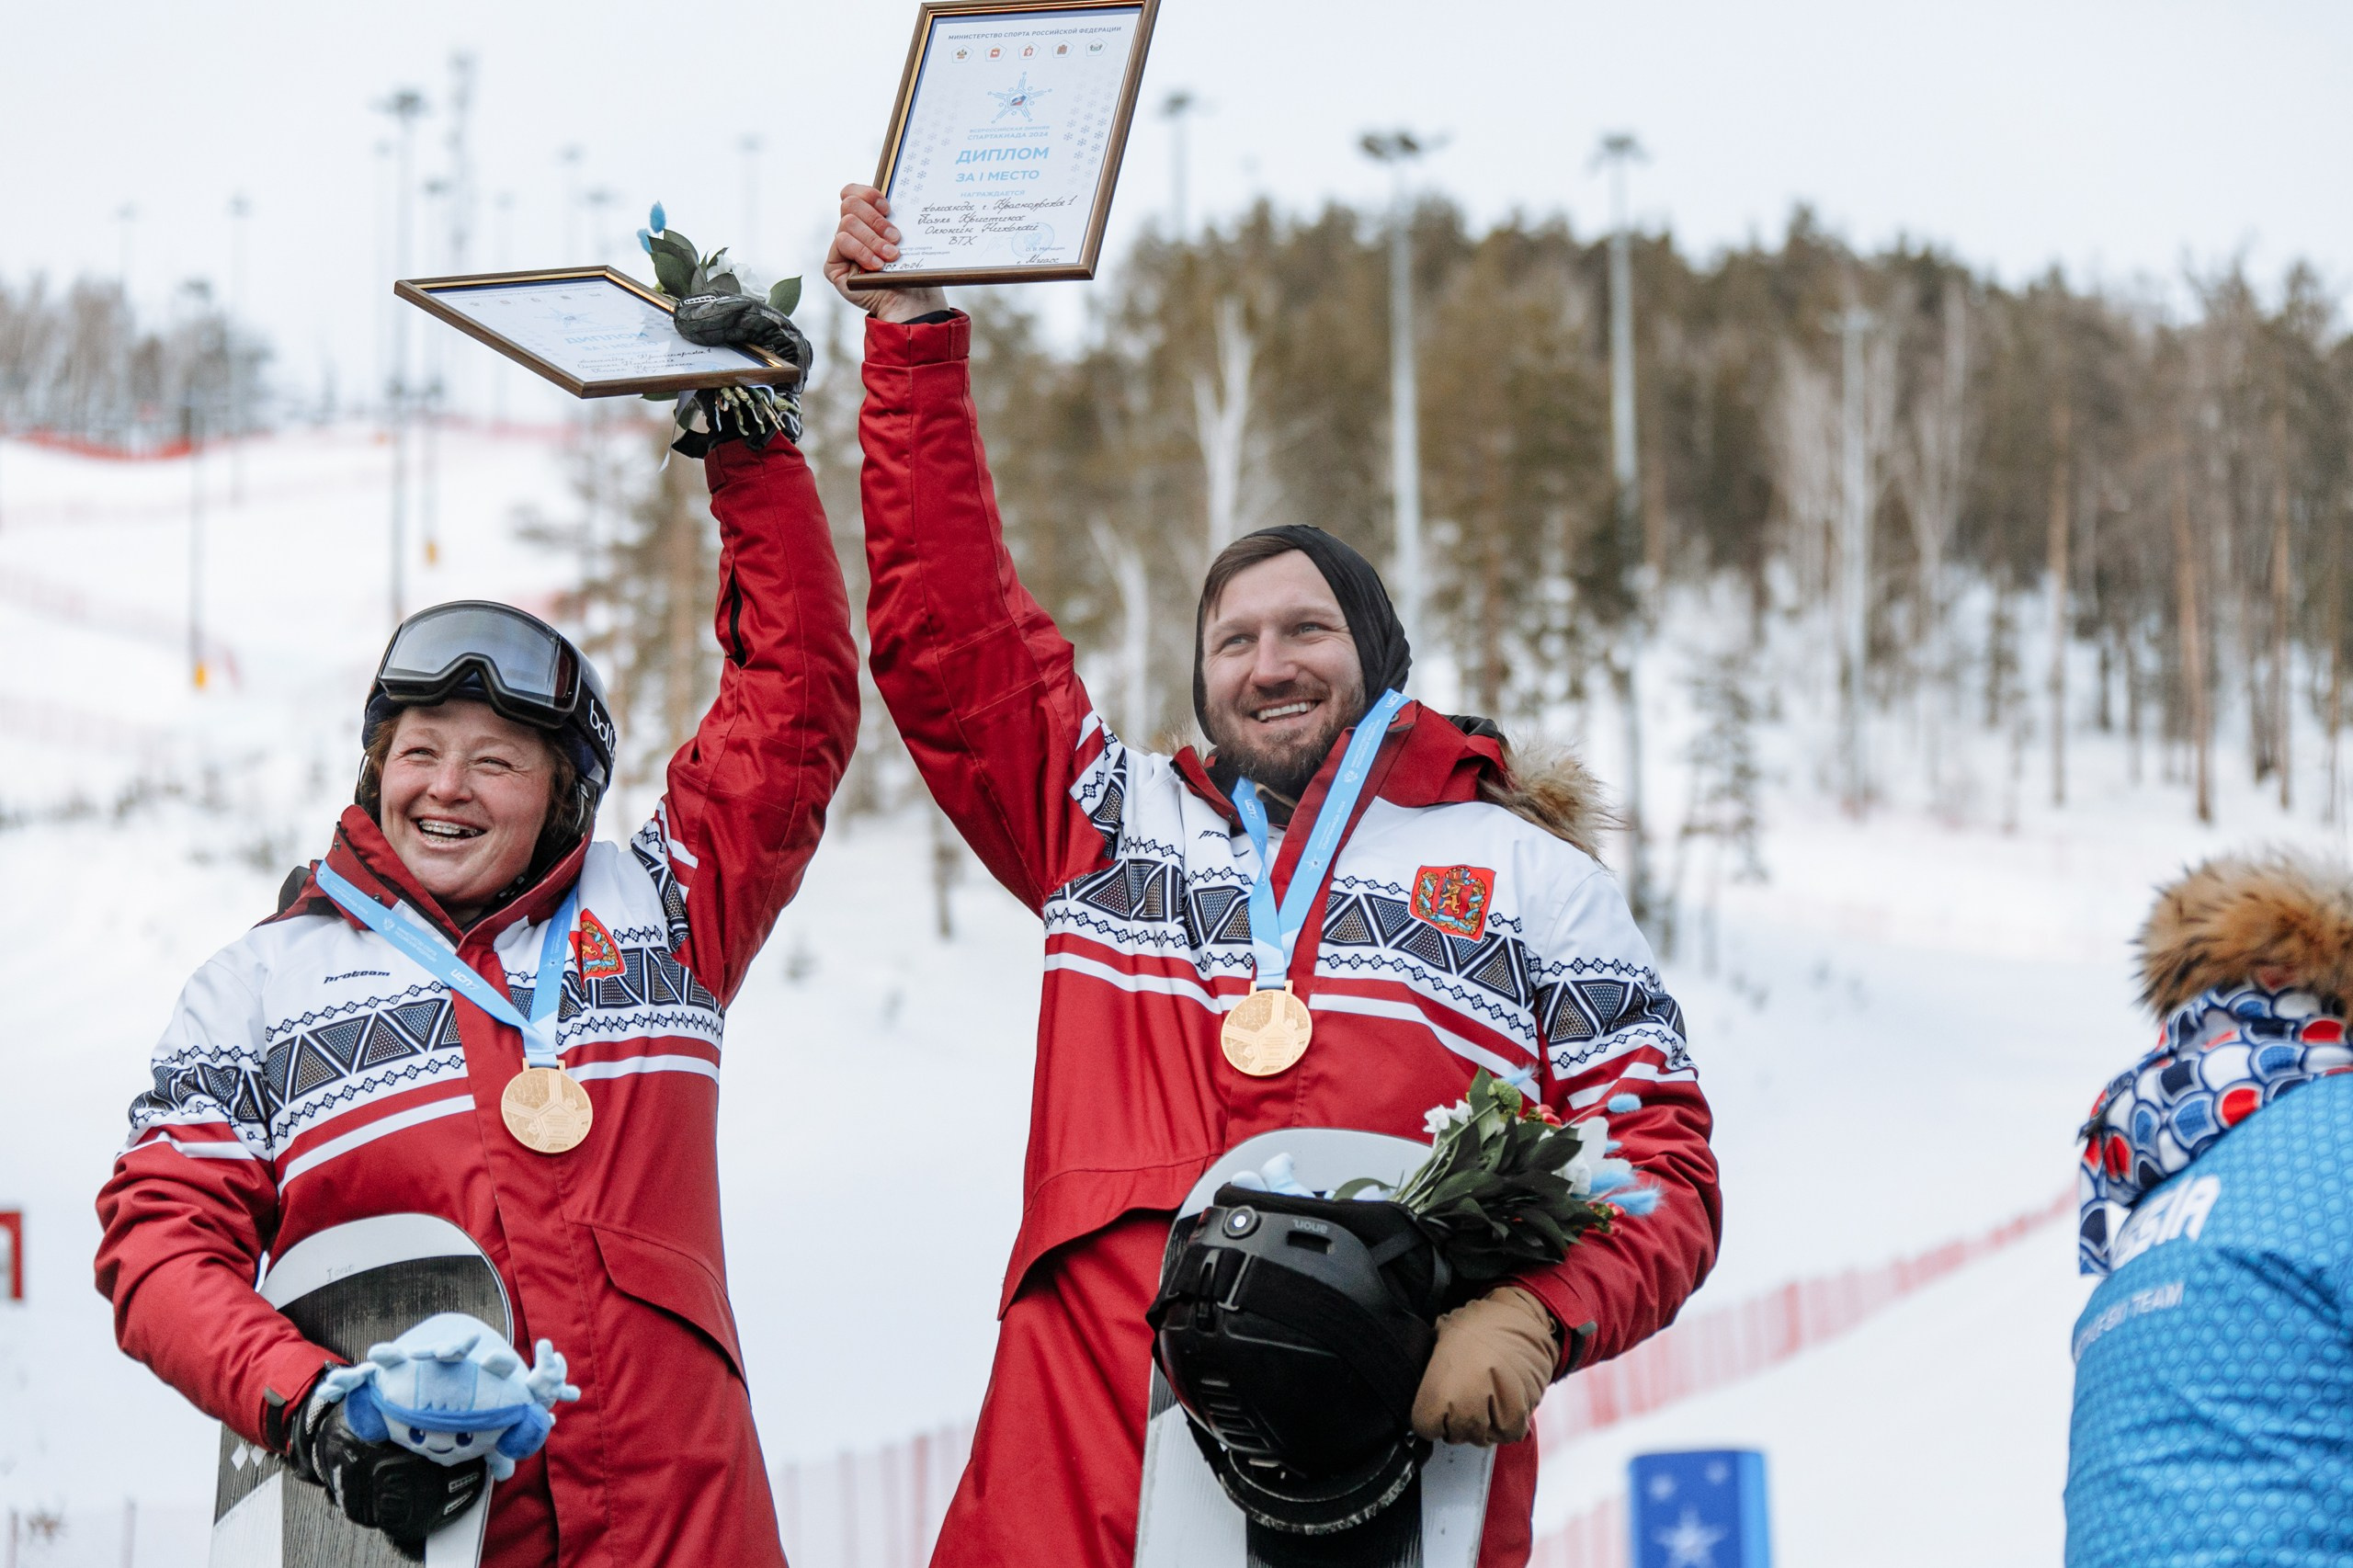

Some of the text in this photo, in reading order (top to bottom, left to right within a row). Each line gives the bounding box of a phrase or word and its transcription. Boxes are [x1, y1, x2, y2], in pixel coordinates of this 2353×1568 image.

[1031, 28, 1077, 37] РОССИЙСКОЙ
[1078, 26, 1122, 35] ФЕДЕРАЦИИ
[967, 132, 1027, 141] СПАРТАКИАДА
[955, 146, 1050, 165] ДИПЛОМ
[955, 172, 975, 182] ЗА
[987, 169, 1040, 181] МЕСТО
[960, 189, 1026, 198] НАГРАЖДАЕТСЯ
[563, 331, 649, 345] ДИПЛОМ
[324, 970, 391, 984] proteam
